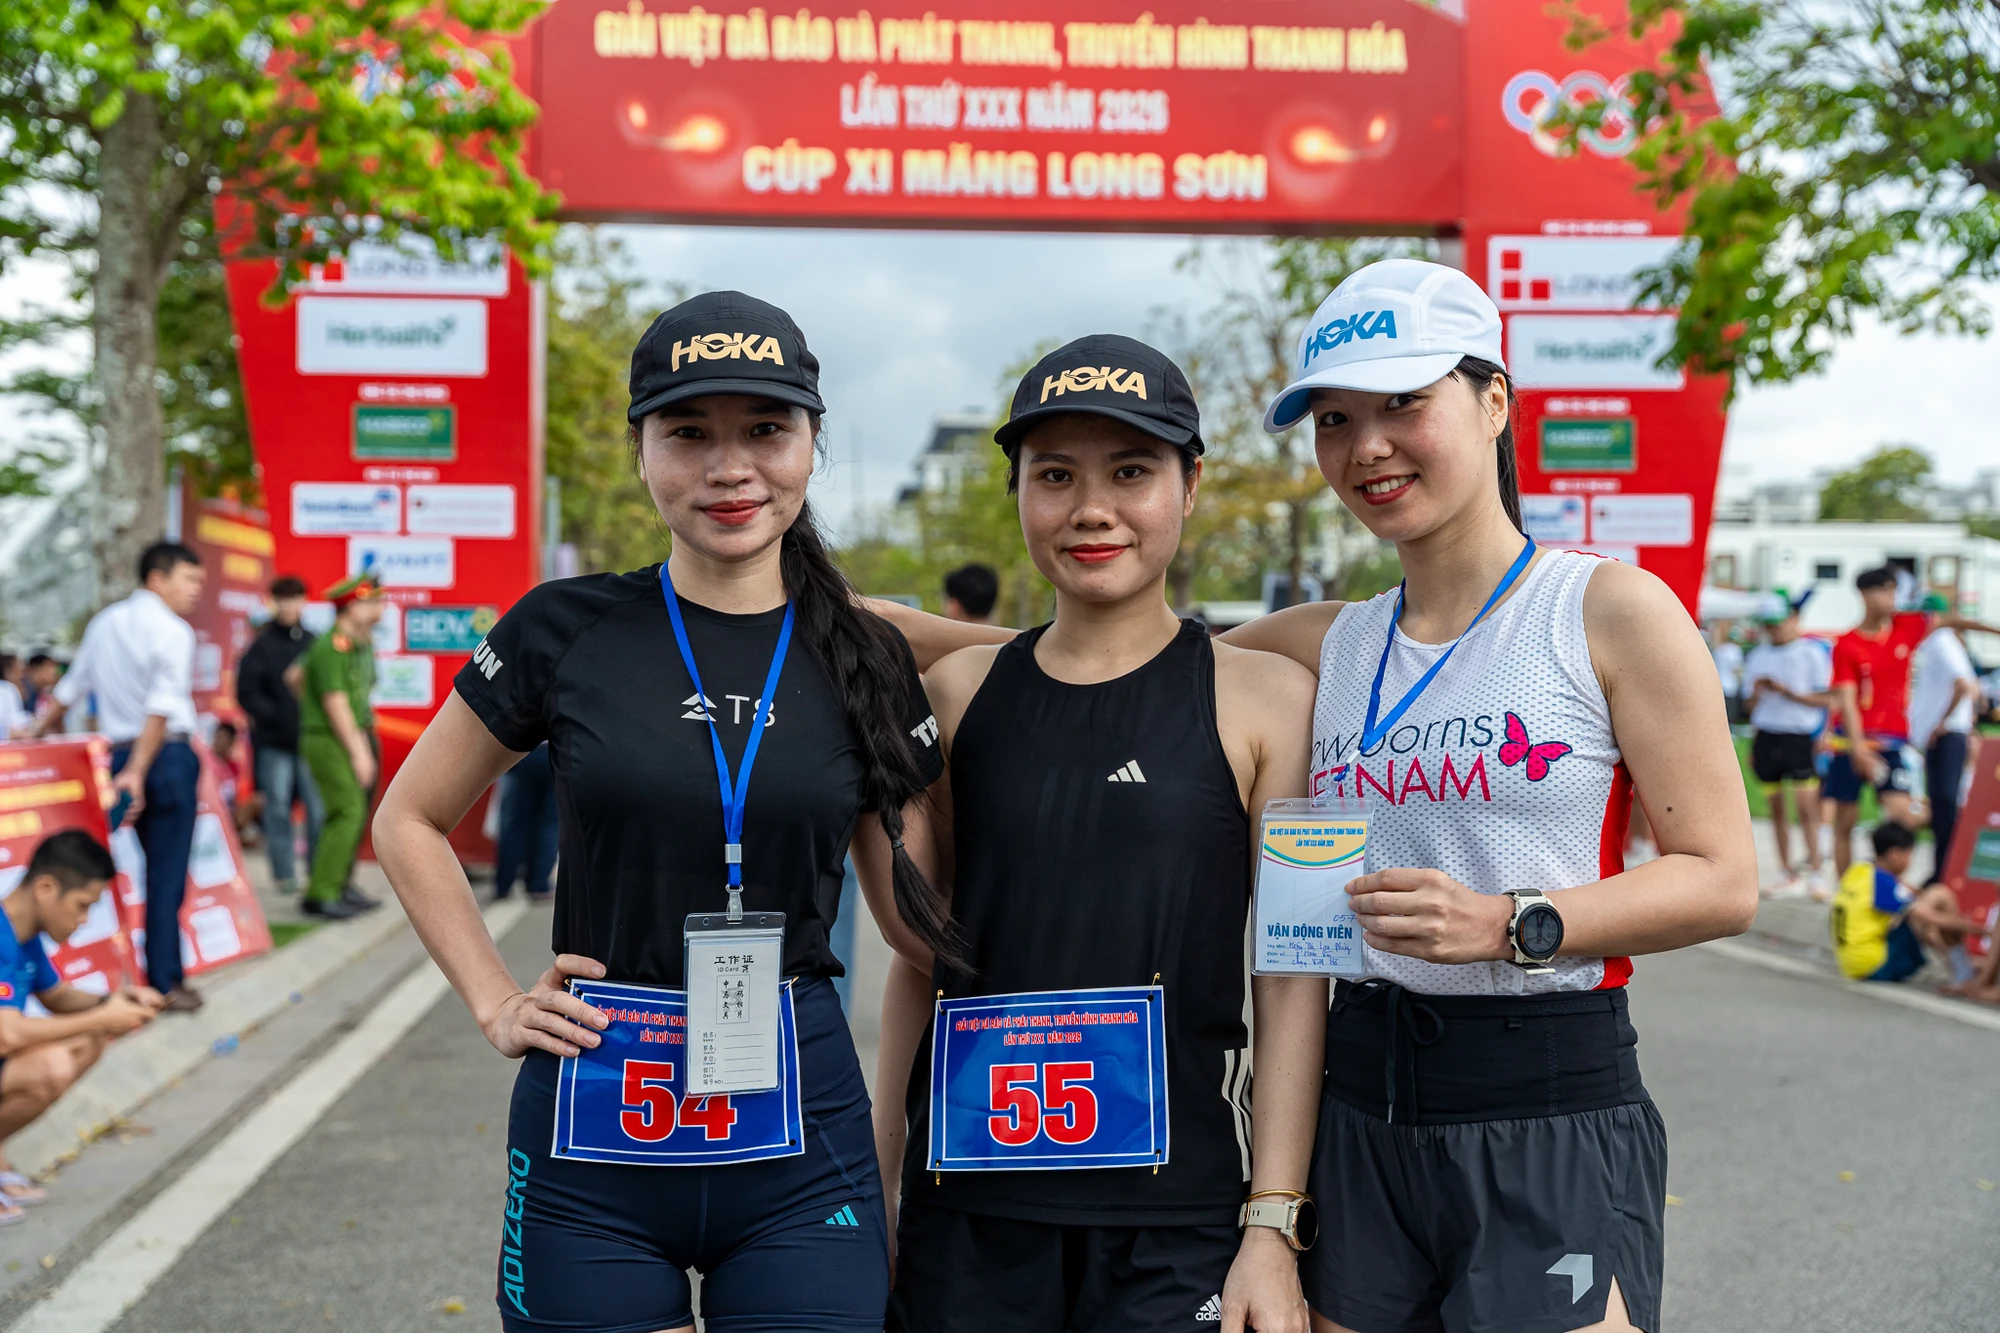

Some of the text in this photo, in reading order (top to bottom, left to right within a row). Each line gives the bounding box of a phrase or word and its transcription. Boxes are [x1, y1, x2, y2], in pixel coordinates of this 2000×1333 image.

[659, 5, 724, 67] VIỆT
[772, 8, 834, 62] BÁO
[835, 9, 878, 63] VÀ
[880, 11, 955, 64] PHÁT
[958, 20, 1062, 71] THANH,
[1176, 17, 1249, 70] HÌNH
[1251, 26, 1345, 72] THANH
[840, 71, 898, 128] LẦN
[962, 86, 1023, 130] XXX
[1025, 80, 1095, 131] NĂM
[743, 138, 1267, 201] CÚP XI MĂNG LONG SƠN
[671, 332, 784, 372] HOKA
[1304, 310, 1397, 368] HOKA
[1040, 366, 1147, 404] HOKA
[473, 636, 503, 681] UN
[1309, 751, 1492, 807] IETNAM
[1267, 922, 1352, 940] VẬN ĐỘNG VIÊN
[714, 955, 754, 964] 工作证
[650, 1012, 667, 1026] PHÁT
[1004, 1031, 1017, 1046] LẦN
[1031, 1033, 1045, 1044] XXX
[1047, 1030, 1064, 1044] NĂM
[1012, 1014, 1028, 1027] PHÁT
[1029, 1015, 1053, 1027] THANH,
[1054, 1011, 1080, 1025] TRUYỀN
[1081, 1011, 1098, 1025] HÌNH
[1099, 1012, 1122, 1024] THANH
[1123, 1010, 1139, 1023] HÓA
[620, 1058, 737, 1142] 54
[988, 1061, 1098, 1146] 55
[503, 1148, 531, 1317] ADIZERO
[1195, 1310, 1221, 1321] adid
